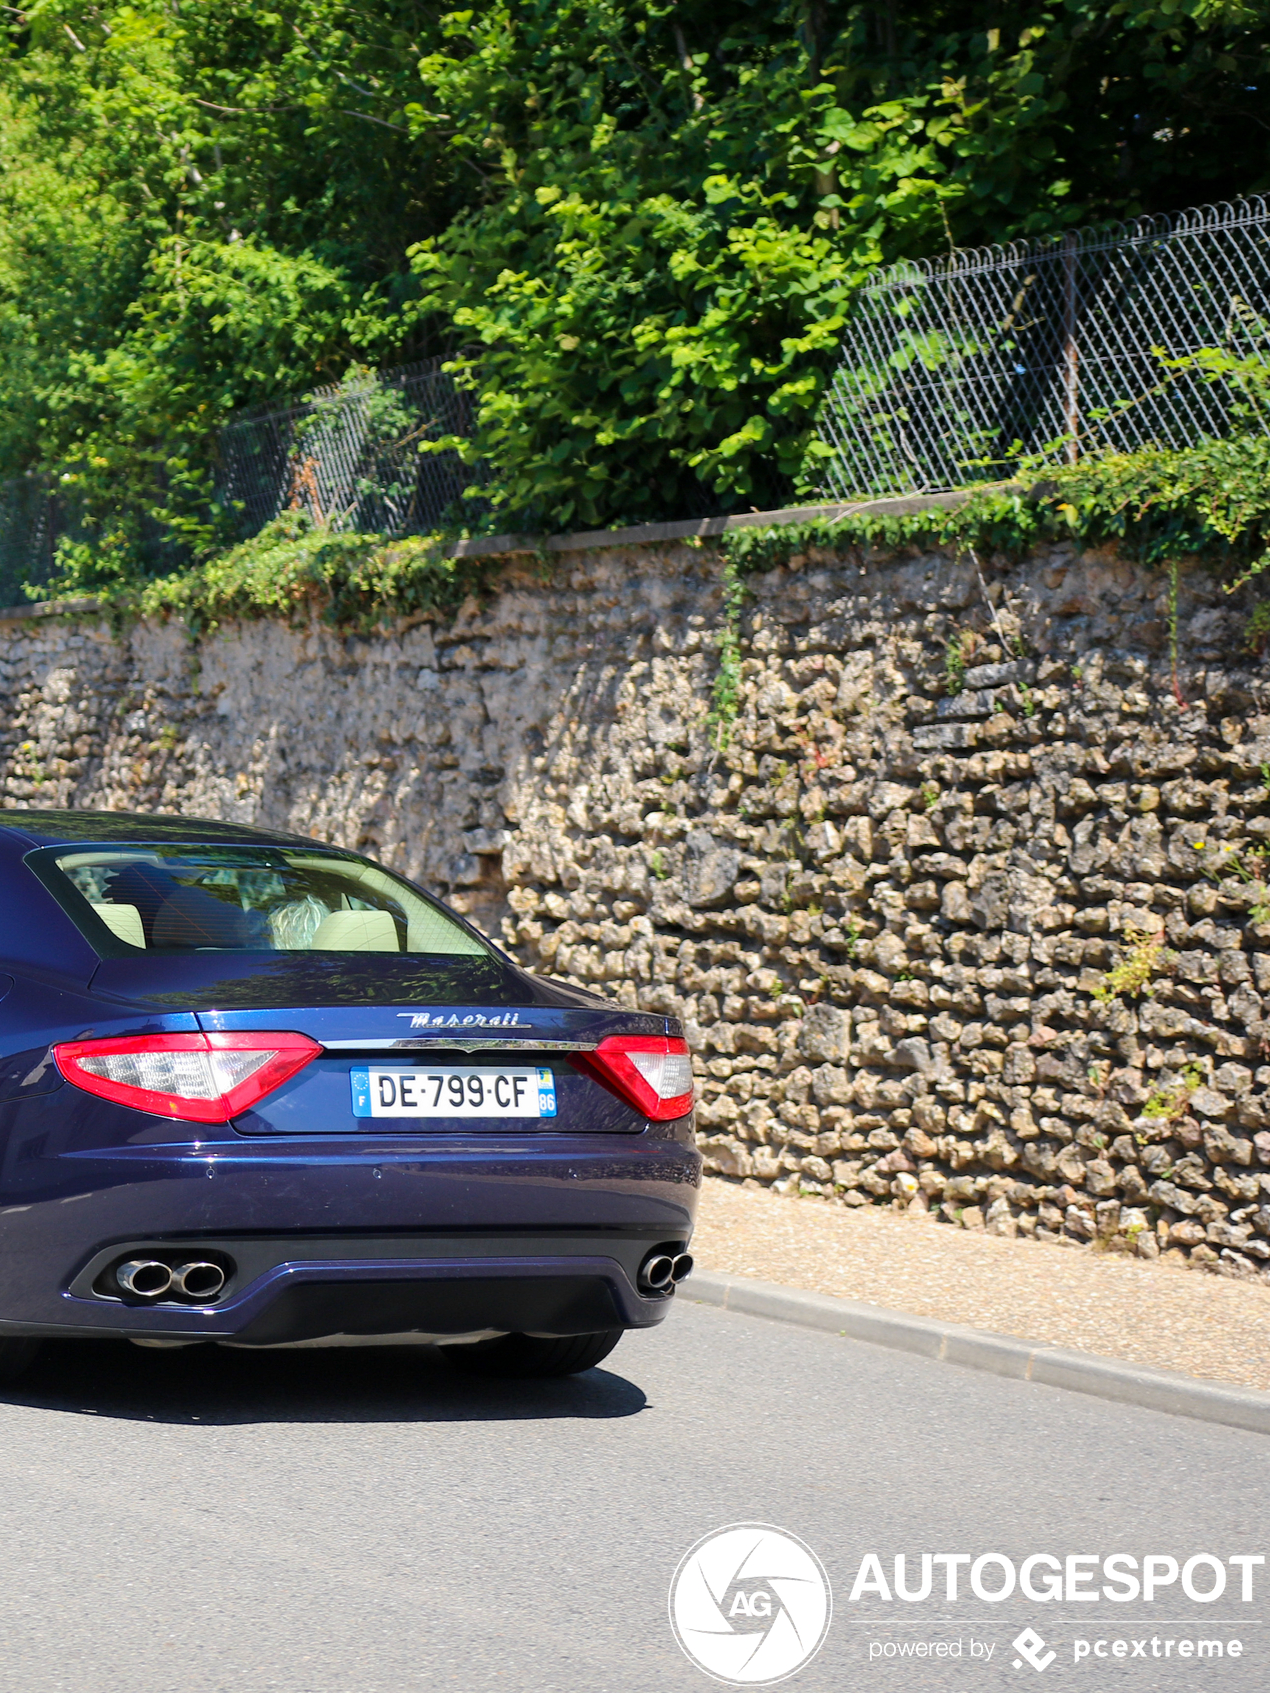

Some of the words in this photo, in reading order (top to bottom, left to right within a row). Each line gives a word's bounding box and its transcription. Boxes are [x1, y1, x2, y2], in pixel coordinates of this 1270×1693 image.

[397, 1012, 531, 1028] Maserati
[359, 1096, 365, 1106] F
[540, 1094, 555, 1111] 86
